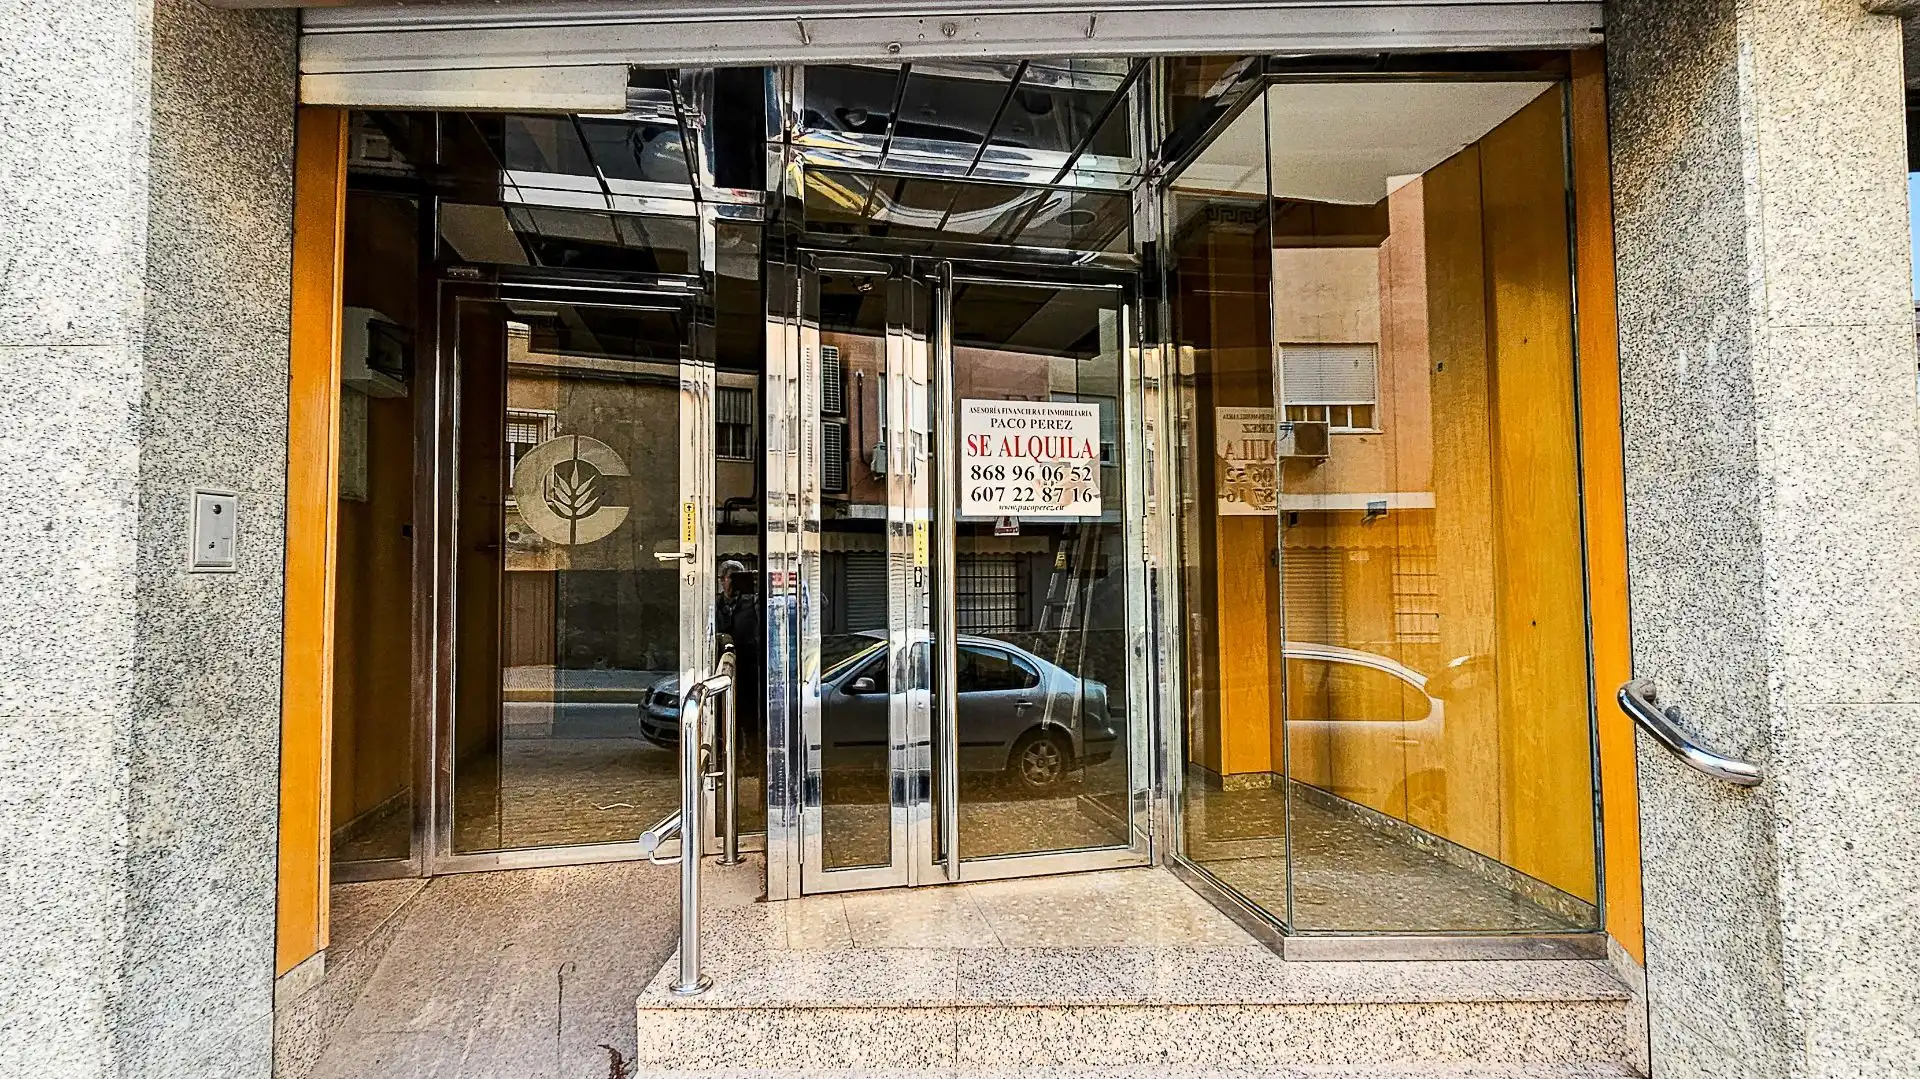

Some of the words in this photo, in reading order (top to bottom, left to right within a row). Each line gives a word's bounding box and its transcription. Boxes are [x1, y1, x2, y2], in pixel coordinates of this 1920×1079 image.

[1002, 407, 1041, 416] FINANCIERA
[1048, 409, 1093, 417] INMOBILIARIA
[990, 418, 1026, 429] PACO
[1030, 419, 1073, 430] PEREZ
[967, 433, 992, 458] SE
[998, 435, 1095, 463] ALQUILA
[970, 464, 1006, 482] 868
[1012, 465, 1035, 482] 96
[1041, 465, 1064, 482] 06
[1070, 466, 1092, 482] 52
[970, 486, 1006, 502] 607
[1012, 486, 1035, 502] 22
[1041, 487, 1064, 503] 87
[1072, 487, 1093, 503] 16
